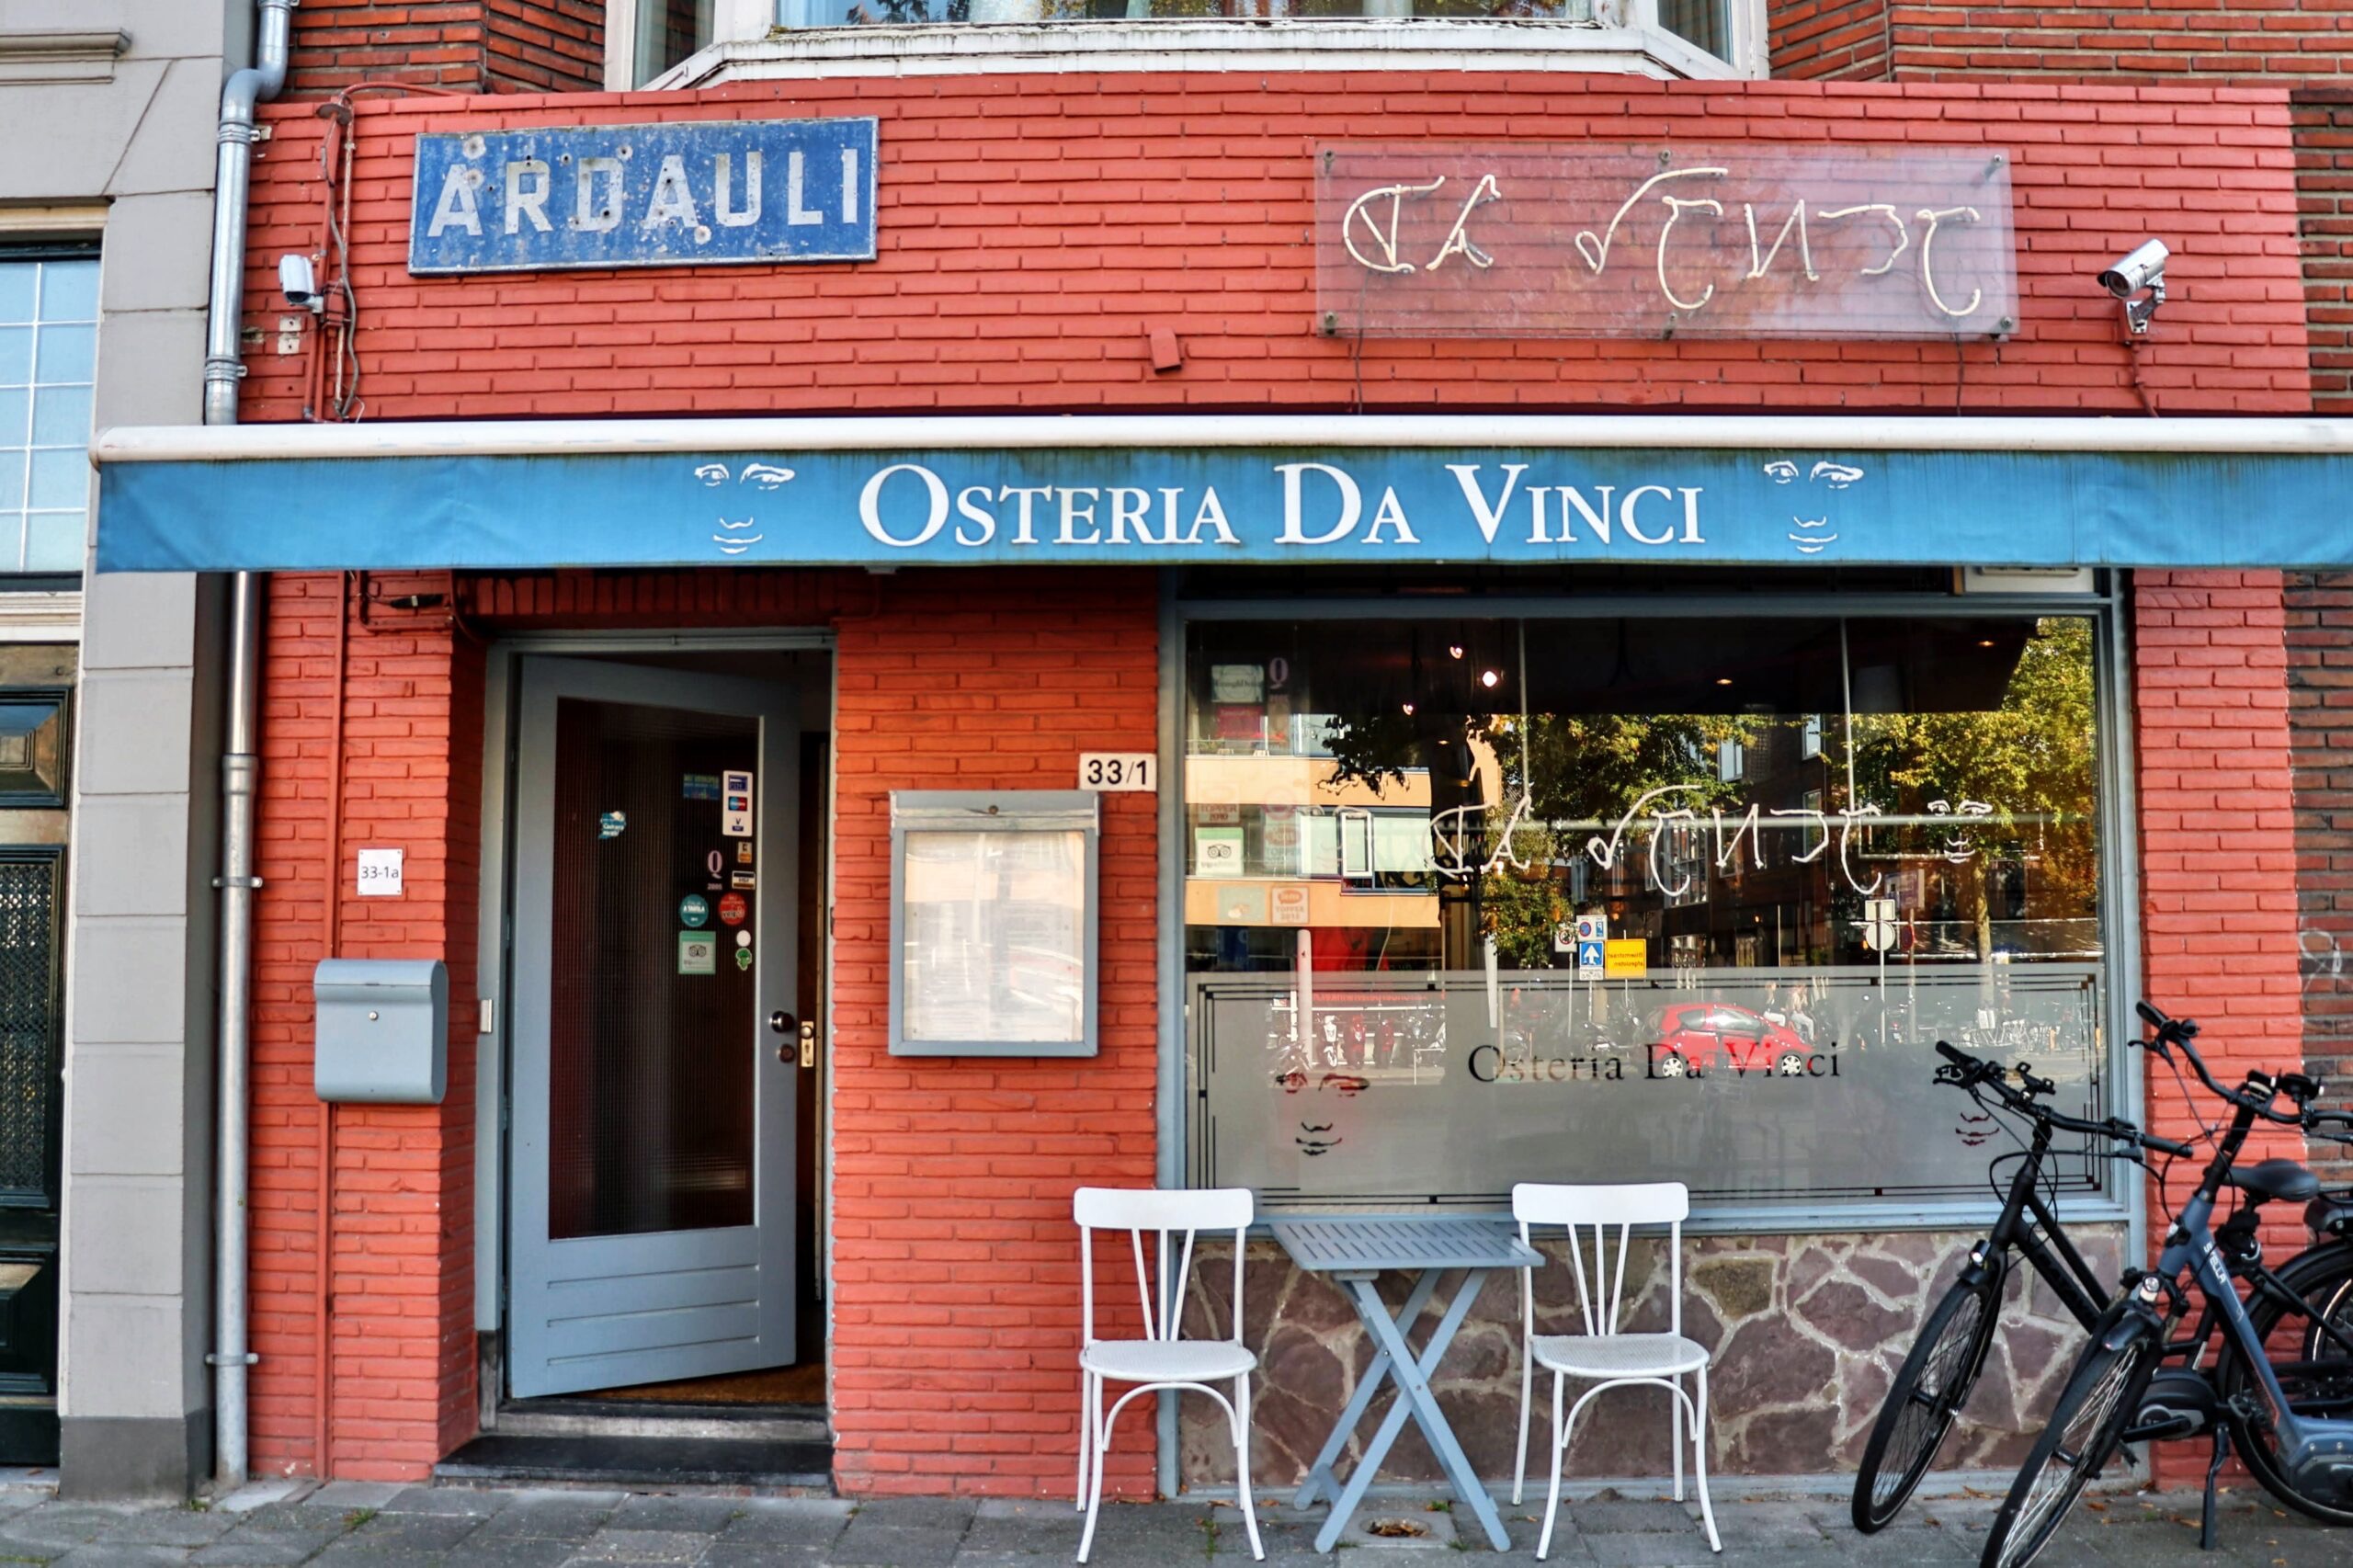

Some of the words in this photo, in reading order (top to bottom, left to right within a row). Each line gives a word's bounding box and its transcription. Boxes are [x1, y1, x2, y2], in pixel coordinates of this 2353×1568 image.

[426, 148, 859, 238] ARDAULI
[1087, 759, 1147, 785] 33/1
[361, 866, 399, 879] 33-1a
[1469, 1045, 1624, 1082] Osteria
[1644, 1043, 1704, 1080] Da
[1724, 1041, 1840, 1078] Vinci
